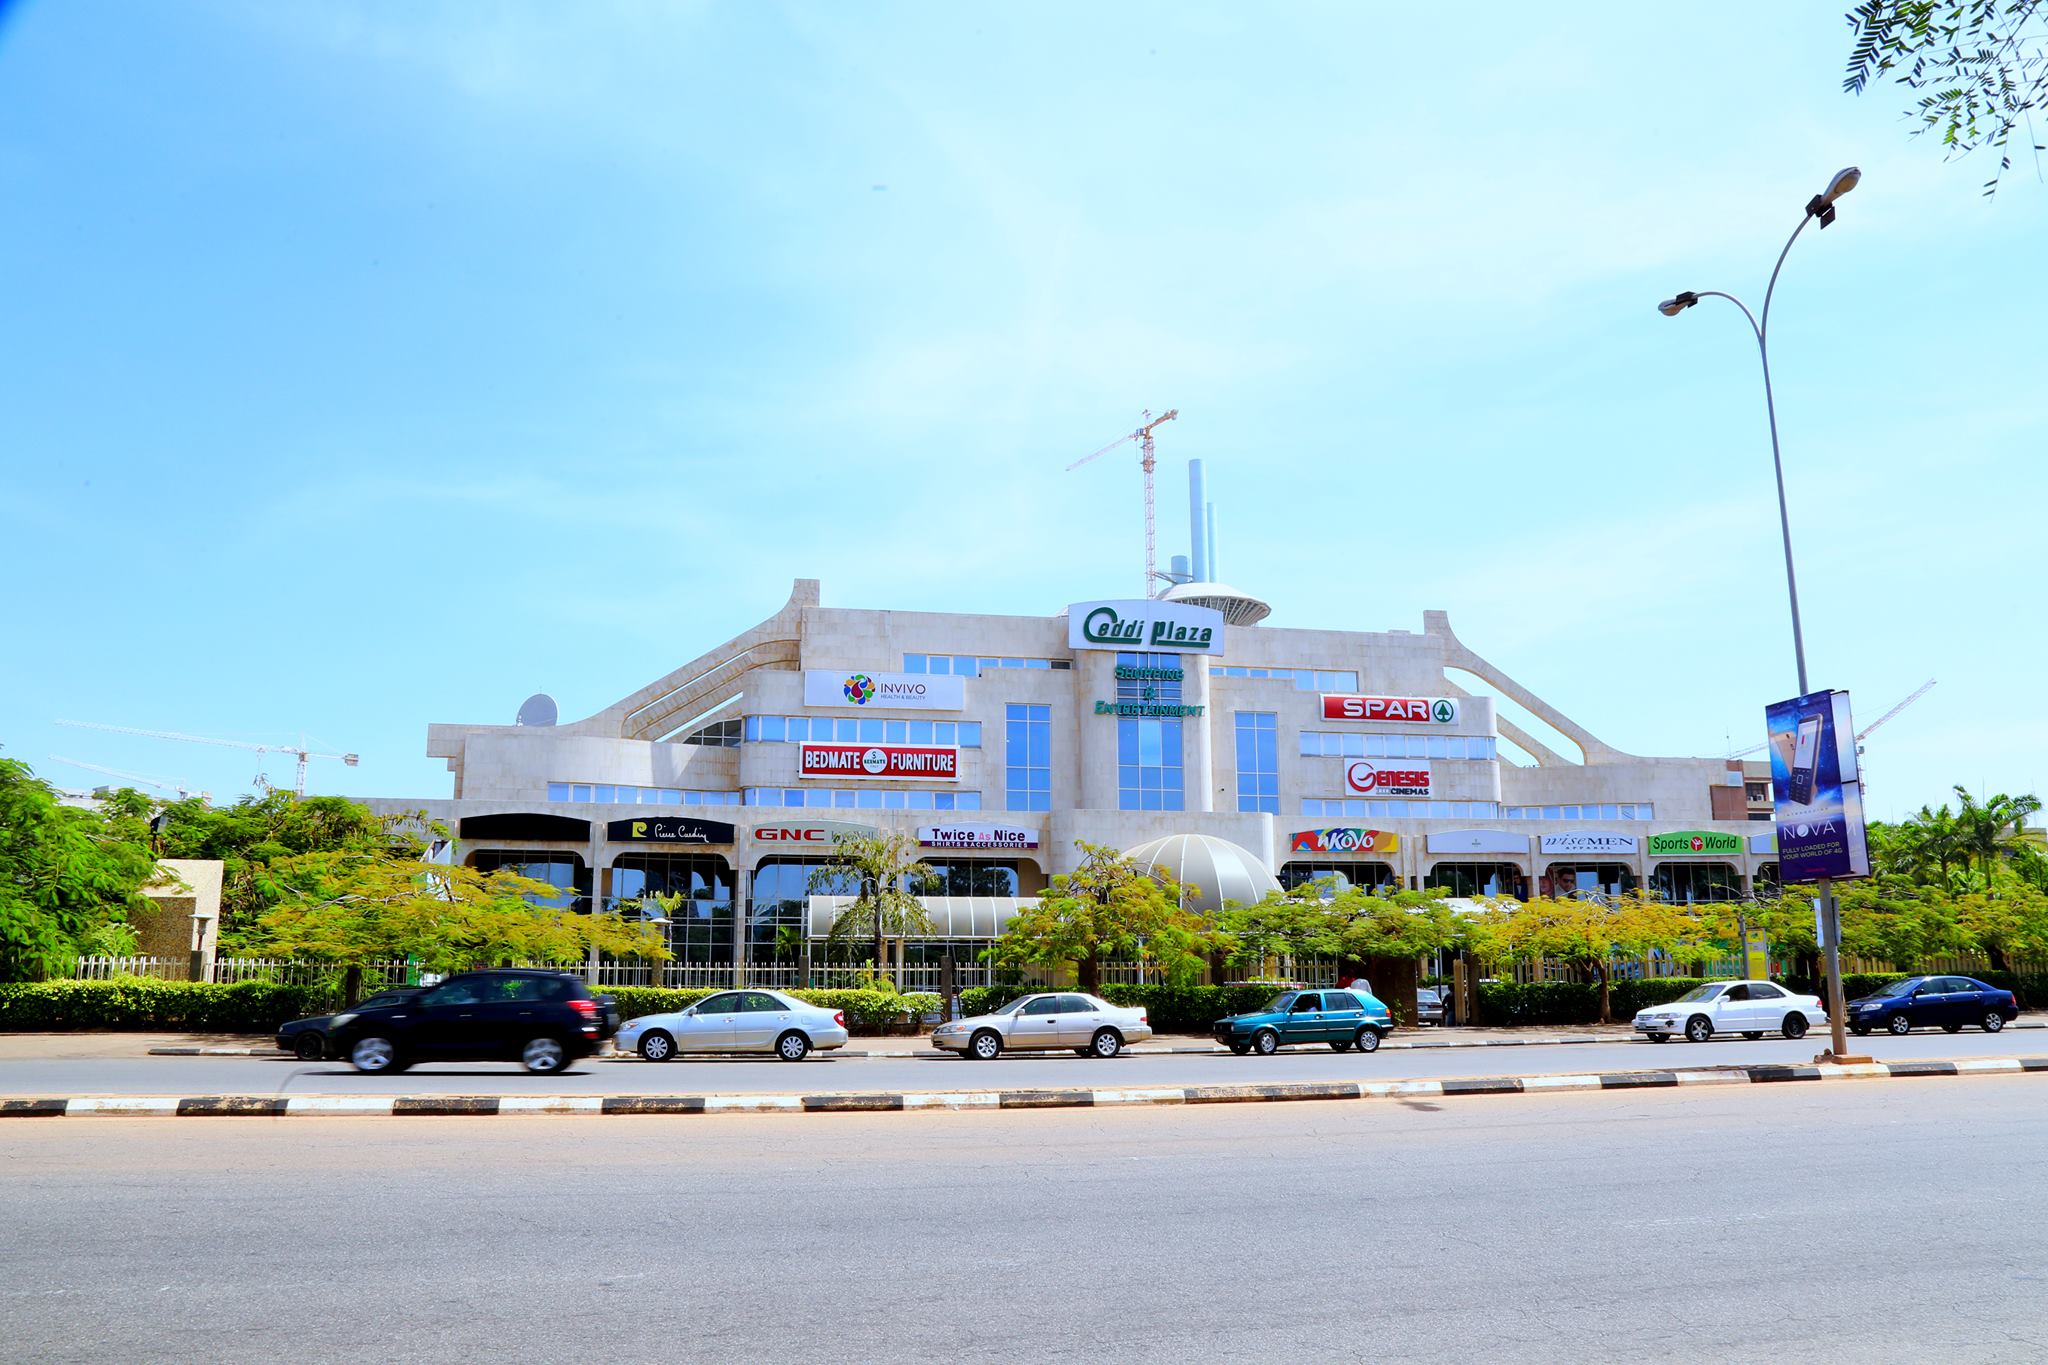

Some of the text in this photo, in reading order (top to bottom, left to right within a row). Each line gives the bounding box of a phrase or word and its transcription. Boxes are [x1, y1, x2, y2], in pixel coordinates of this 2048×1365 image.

[1083, 606, 1145, 644] Ceddi
[880, 683, 926, 695] INVIVO
[1343, 699, 1428, 719] SPAR
[805, 751, 861, 769] BEDMATE
[891, 752, 954, 771] FURNITURE
[1347, 762, 1430, 793] GENESIS
[1390, 787, 1430, 796] CINEMAS
[755, 828, 825, 841] GNC
[932, 828, 1026, 841] Twice As Nice
[1653, 836, 1737, 852] Sports World
[1782, 841, 1840, 854] FULLY LOADED FOR
[1800, 850, 1823, 858] WORLD
[1834, 847, 1843, 855] 4G
